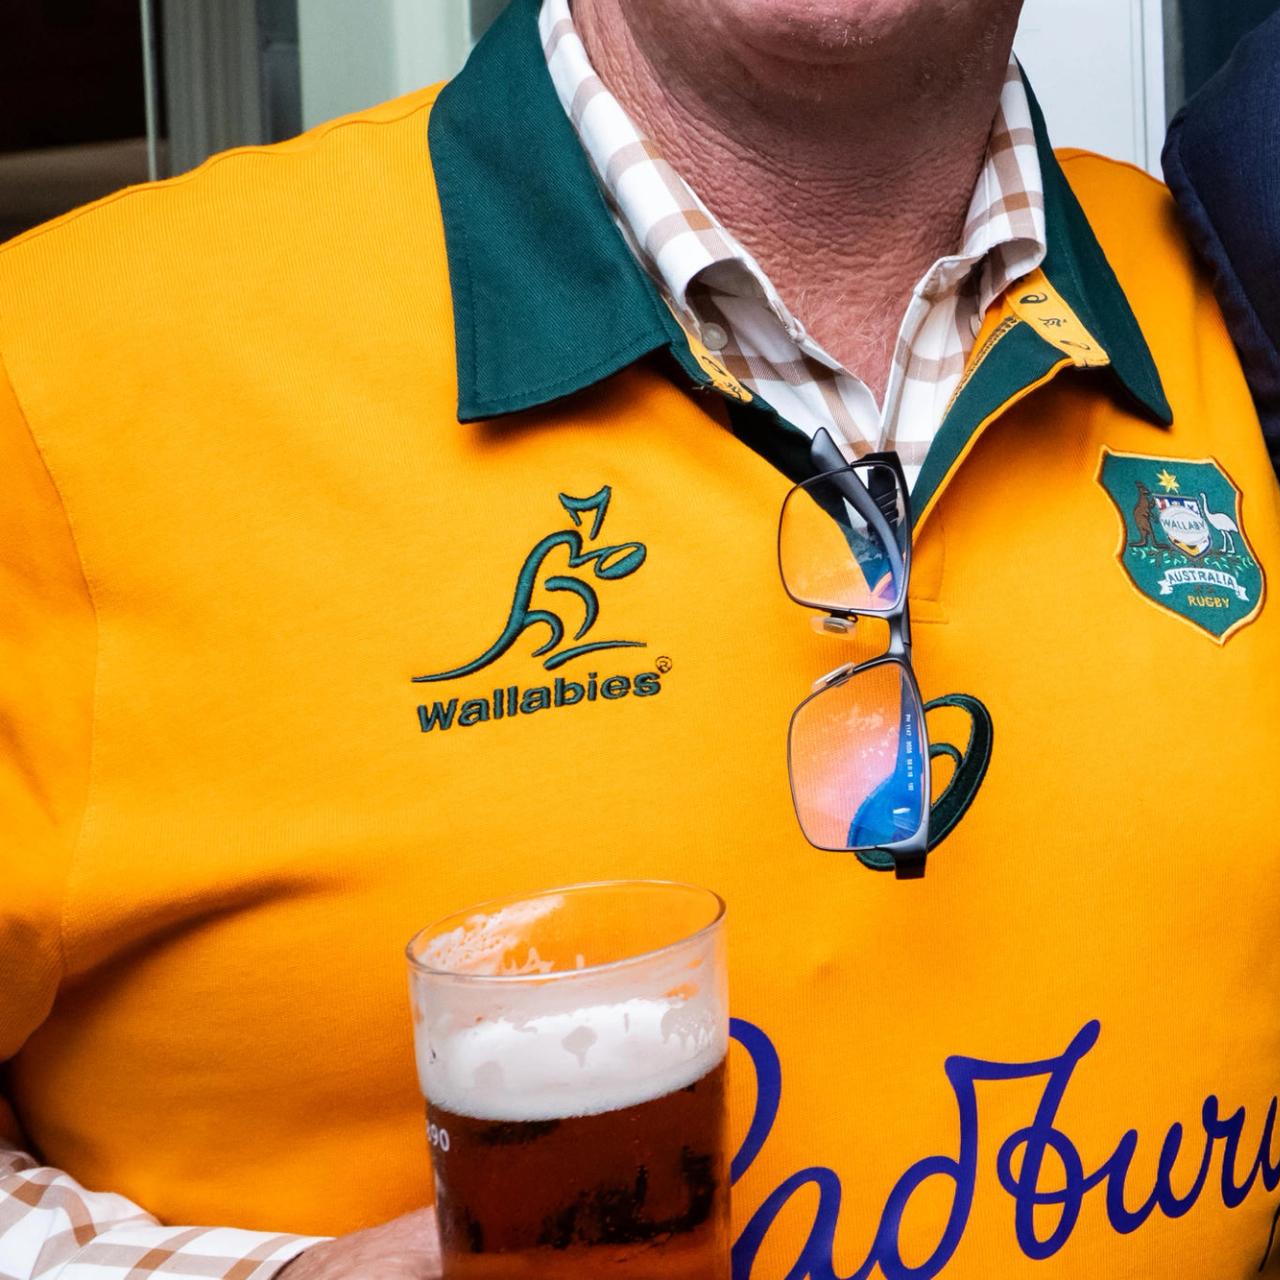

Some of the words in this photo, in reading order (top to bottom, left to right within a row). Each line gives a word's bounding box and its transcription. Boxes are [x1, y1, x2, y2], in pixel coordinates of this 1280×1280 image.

[1168, 570, 1236, 588] AUSTRALIA
[1187, 595, 1230, 608] RUGBY
[417, 672, 662, 733] Wallabies
